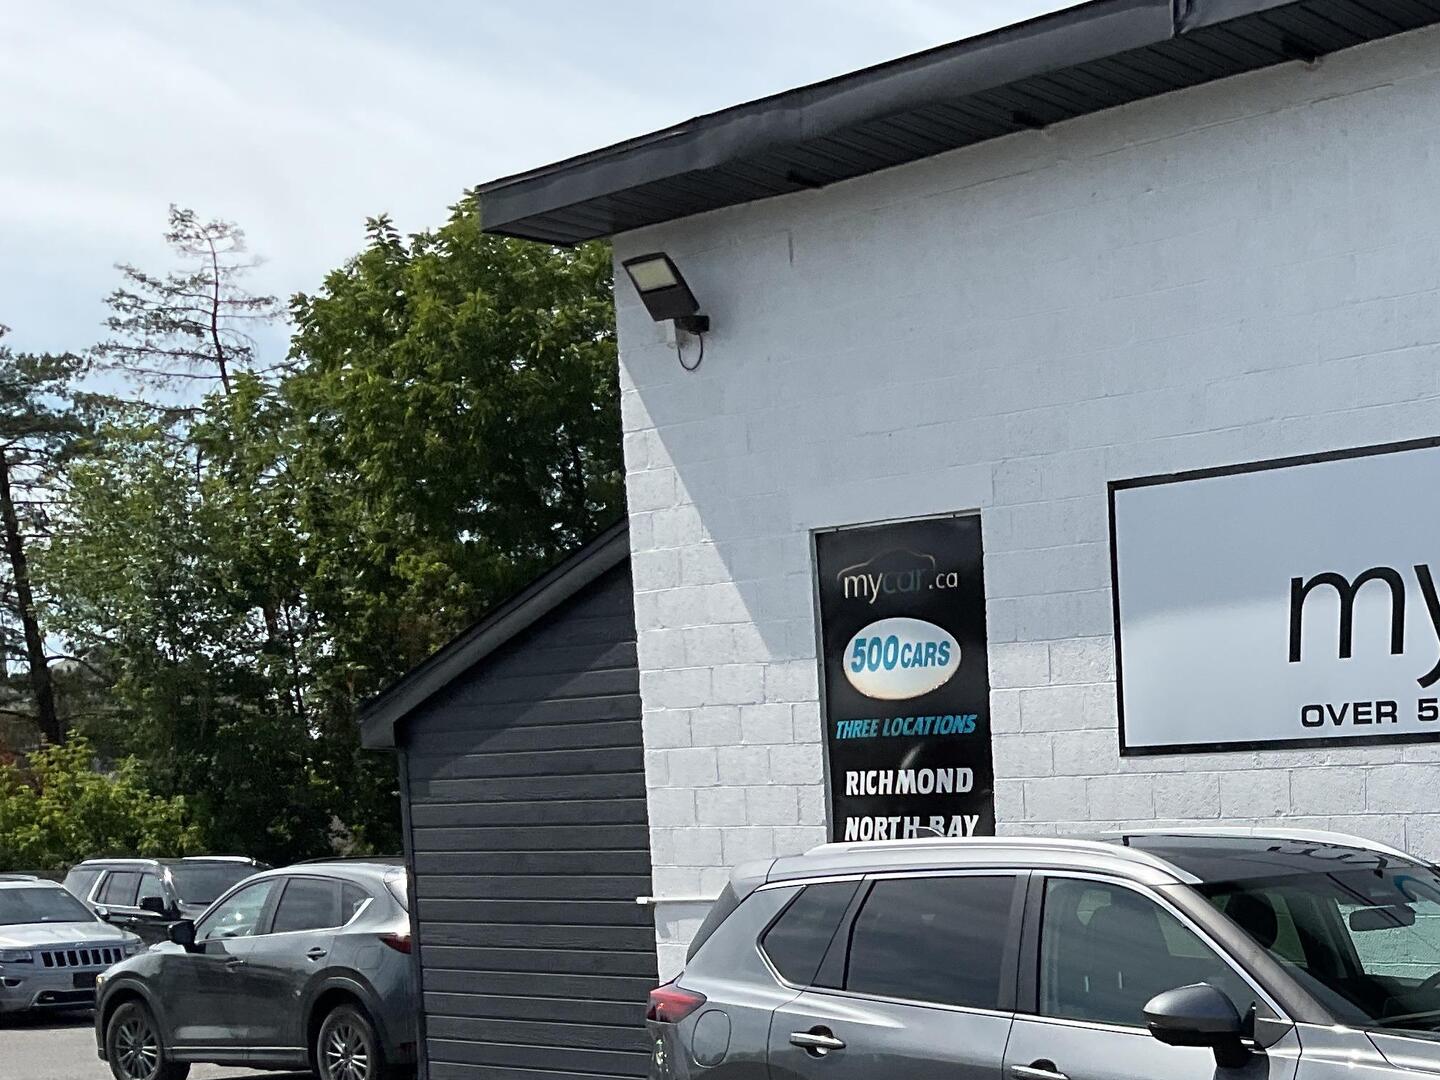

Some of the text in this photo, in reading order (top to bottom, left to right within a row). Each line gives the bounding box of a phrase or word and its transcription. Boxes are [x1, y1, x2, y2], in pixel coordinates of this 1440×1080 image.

[843, 568, 958, 604] mycar.ca
[835, 714, 978, 739] THREE LOCATIONS
[1300, 699, 1398, 728] OVER
[845, 767, 973, 796] RICHMOND
[844, 815, 920, 841] NORTH
